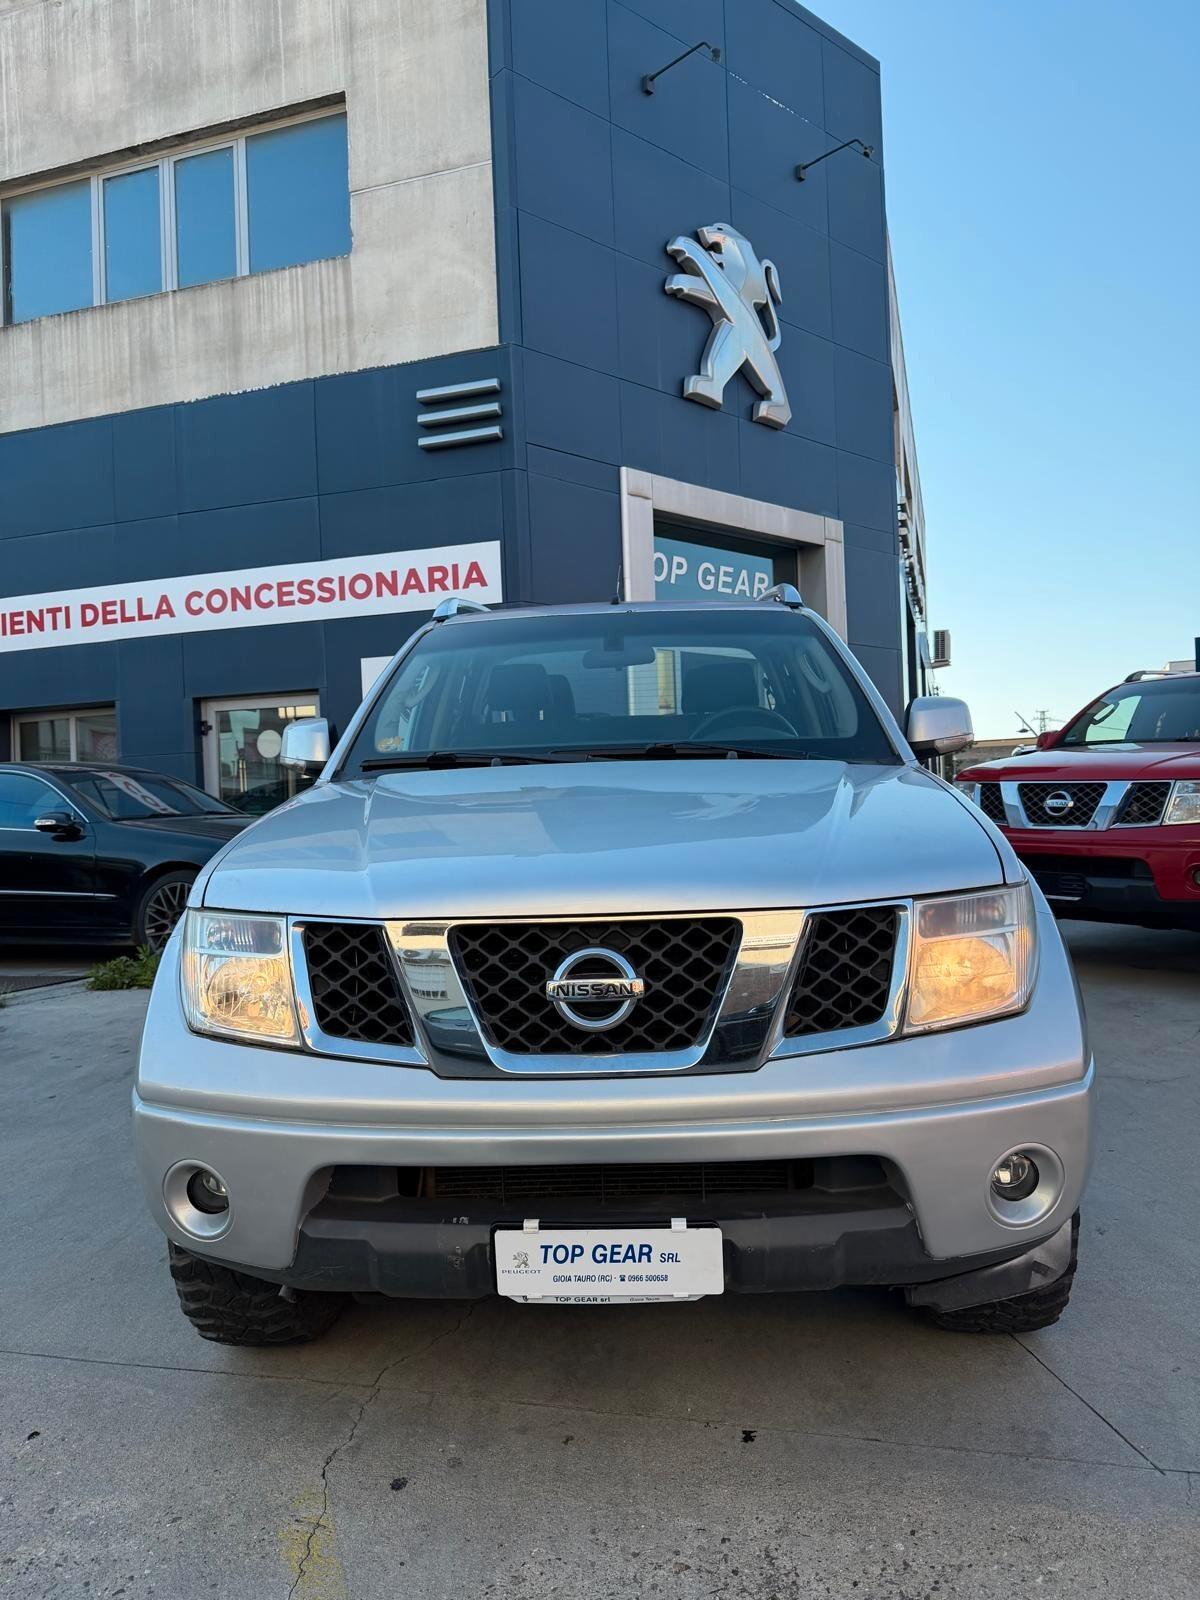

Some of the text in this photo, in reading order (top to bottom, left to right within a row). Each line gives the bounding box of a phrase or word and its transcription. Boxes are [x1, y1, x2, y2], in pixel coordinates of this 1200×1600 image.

[654, 552, 770, 598] OP GEAR
[1, 561, 488, 636] IENTI DELLA CONCESSIONARIA
[555, 983, 633, 997] NISSAN
[540, 1244, 681, 1264] TOP GEAR SRL
[598, 1274, 613, 1283] (RC)
[628, 1274, 644, 1282] 0966
[645, 1274, 669, 1282] 500658
